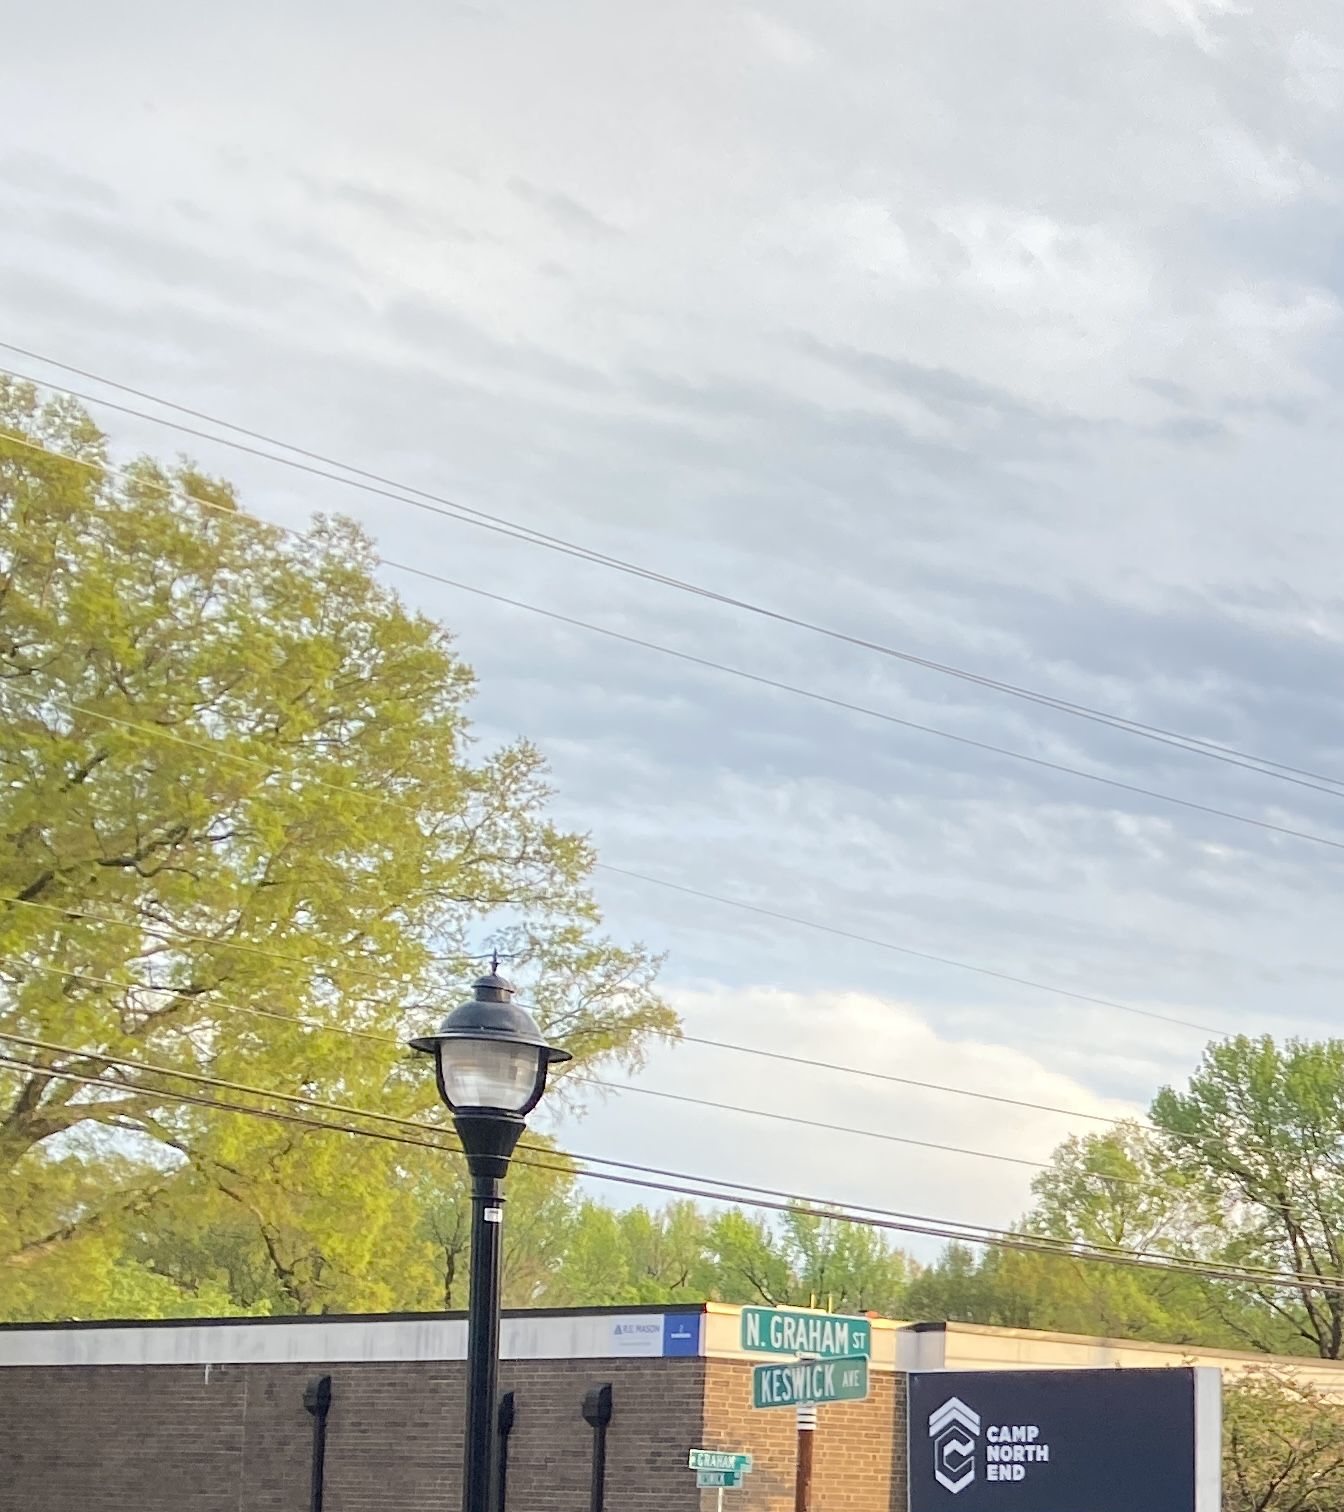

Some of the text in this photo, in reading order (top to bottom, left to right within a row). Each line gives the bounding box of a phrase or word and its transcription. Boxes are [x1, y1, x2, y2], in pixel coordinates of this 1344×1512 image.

[746, 1312, 867, 1355] N. GRAHAM ST
[761, 1363, 860, 1403] KESWICK AVE
[986, 1425, 1039, 1443] CAMP
[986, 1444, 1050, 1462] NORTH
[986, 1464, 1026, 1482] END
